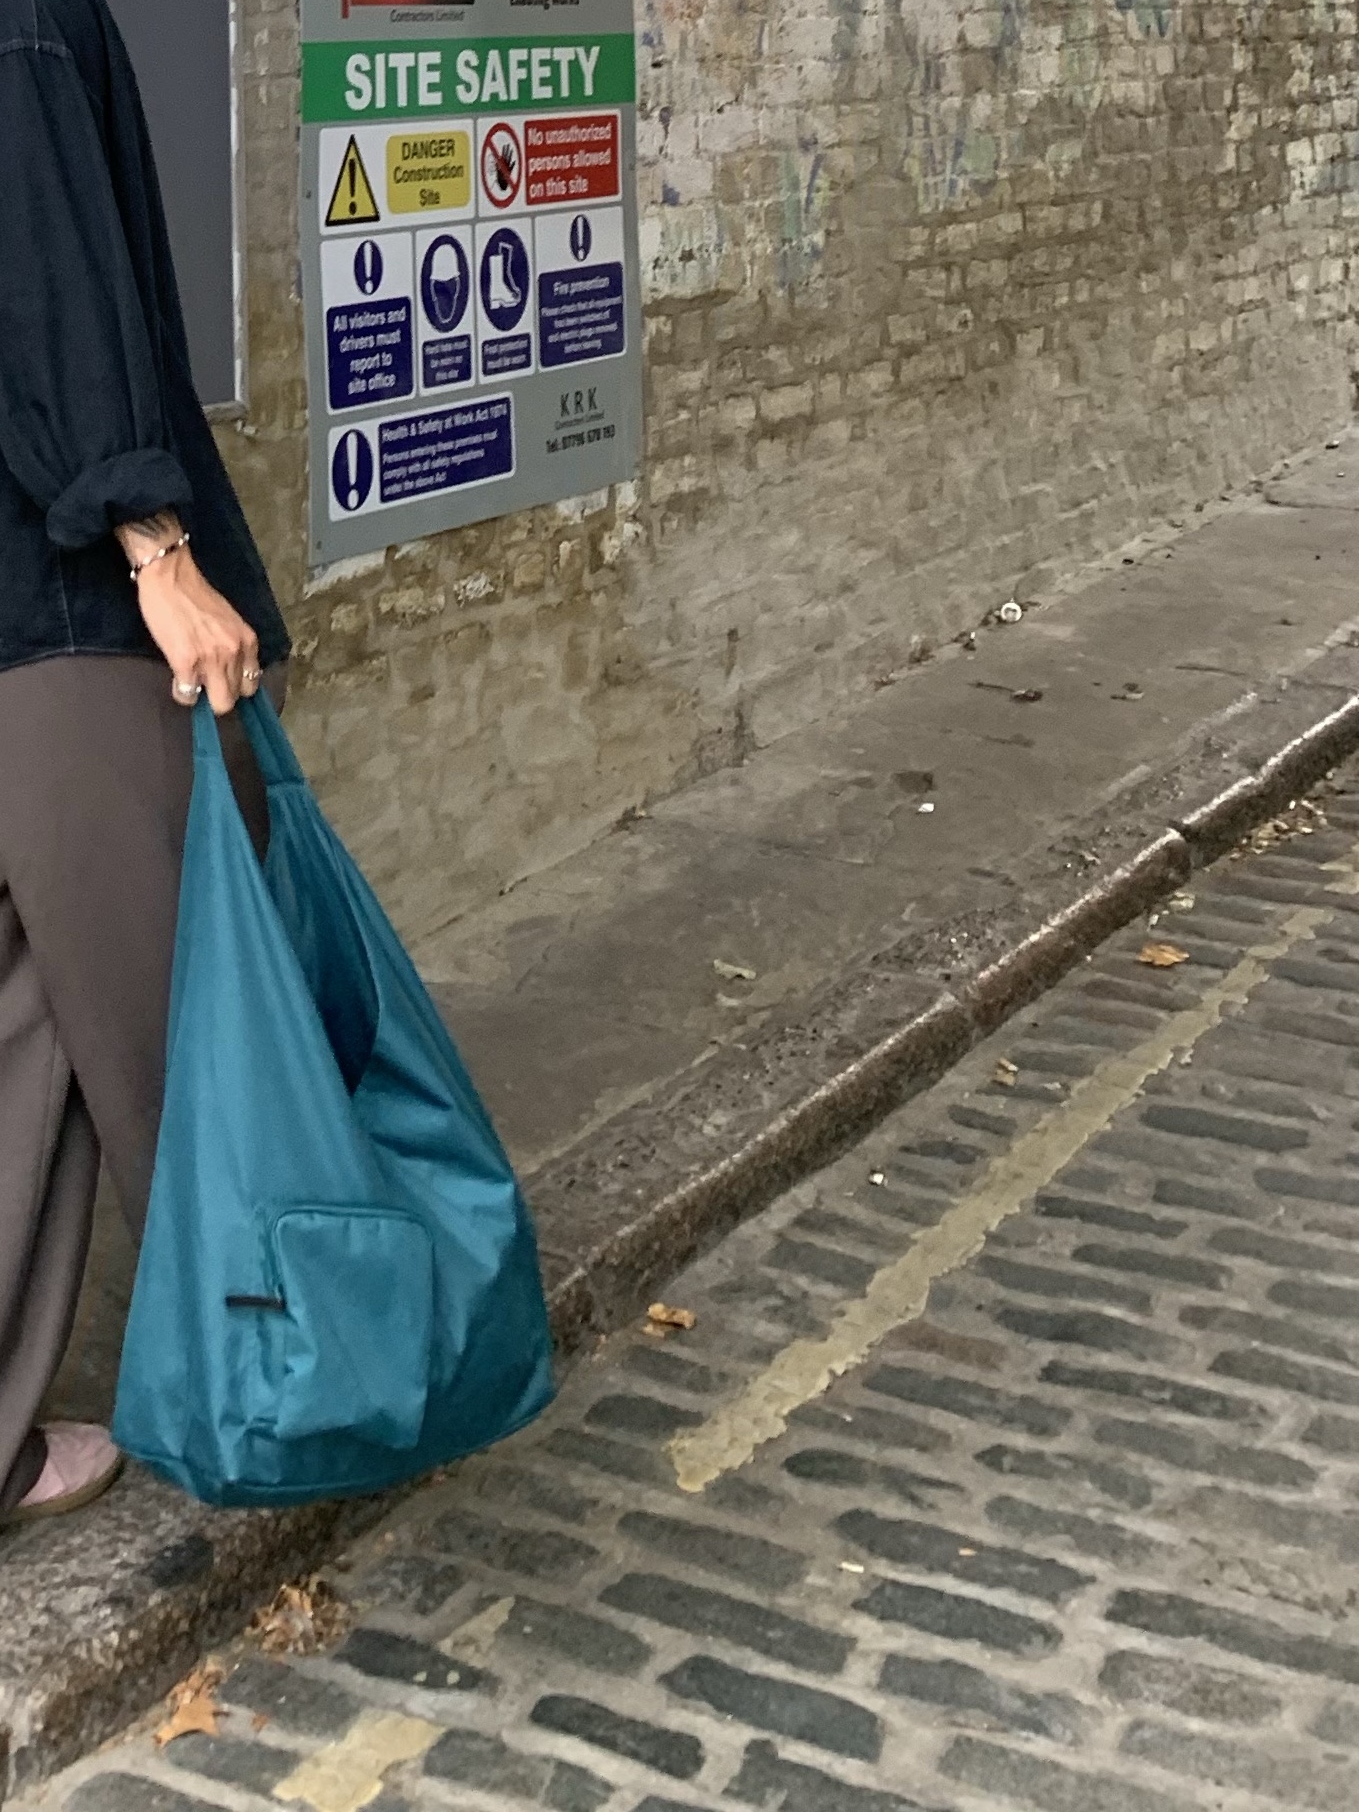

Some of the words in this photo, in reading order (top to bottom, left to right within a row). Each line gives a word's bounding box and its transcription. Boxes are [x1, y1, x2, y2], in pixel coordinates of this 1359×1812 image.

[345, 51, 442, 111] SITE
[455, 46, 601, 104] SAFETY
[527, 128, 543, 145] No
[401, 138, 456, 161] DANGER
[393, 162, 464, 184] Construction
[528, 155, 571, 176] persons
[573, 148, 611, 167] allowed
[418, 188, 440, 206] Site
[529, 182, 544, 197] on
[546, 177, 566, 195] this
[568, 176, 588, 193] site
[333, 315, 348, 333] All
[349, 311, 386, 330] visitors
[387, 306, 406, 323] and
[339, 334, 375, 353] drivers
[376, 328, 401, 346] must
[350, 352, 380, 374] report
[381, 352, 392, 367] to
[347, 377, 367, 395] site
[368, 372, 397, 391] office
